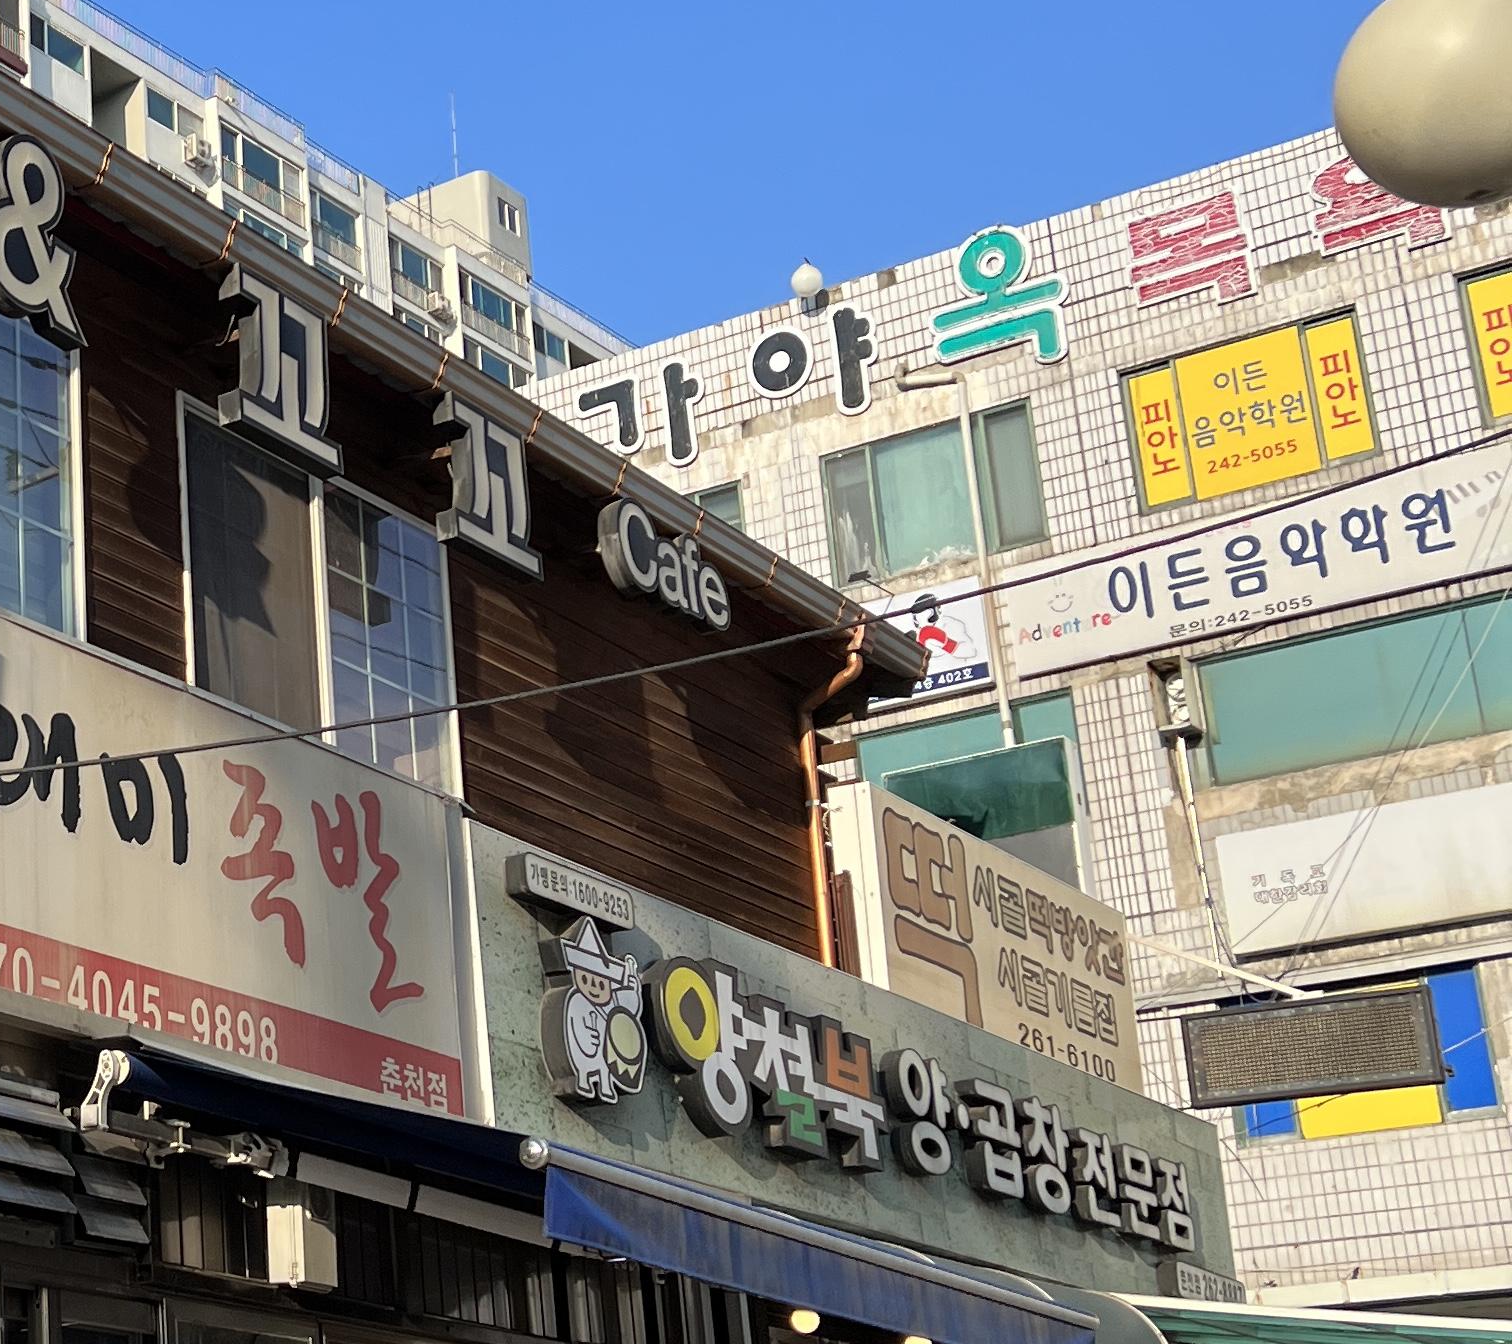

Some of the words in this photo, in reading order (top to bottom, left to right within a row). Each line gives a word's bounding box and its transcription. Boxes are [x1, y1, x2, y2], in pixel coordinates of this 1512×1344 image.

[1213, 360, 1269, 395] 이든
[1320, 349, 1362, 430] 피아노
[1142, 399, 1181, 477] 피아노
[1191, 390, 1307, 449] 음악학원
[1207, 439, 1298, 475] 242-5055
[600, 497, 732, 630] Cafe
[938, 667, 974, 685] 402호
[221, 759, 426, 1016] 족발
[882, 806, 984, 1029] 떡
[380, 1056, 448, 1108] 춘천점
[1019, 1022, 1116, 1083] 261-6100
